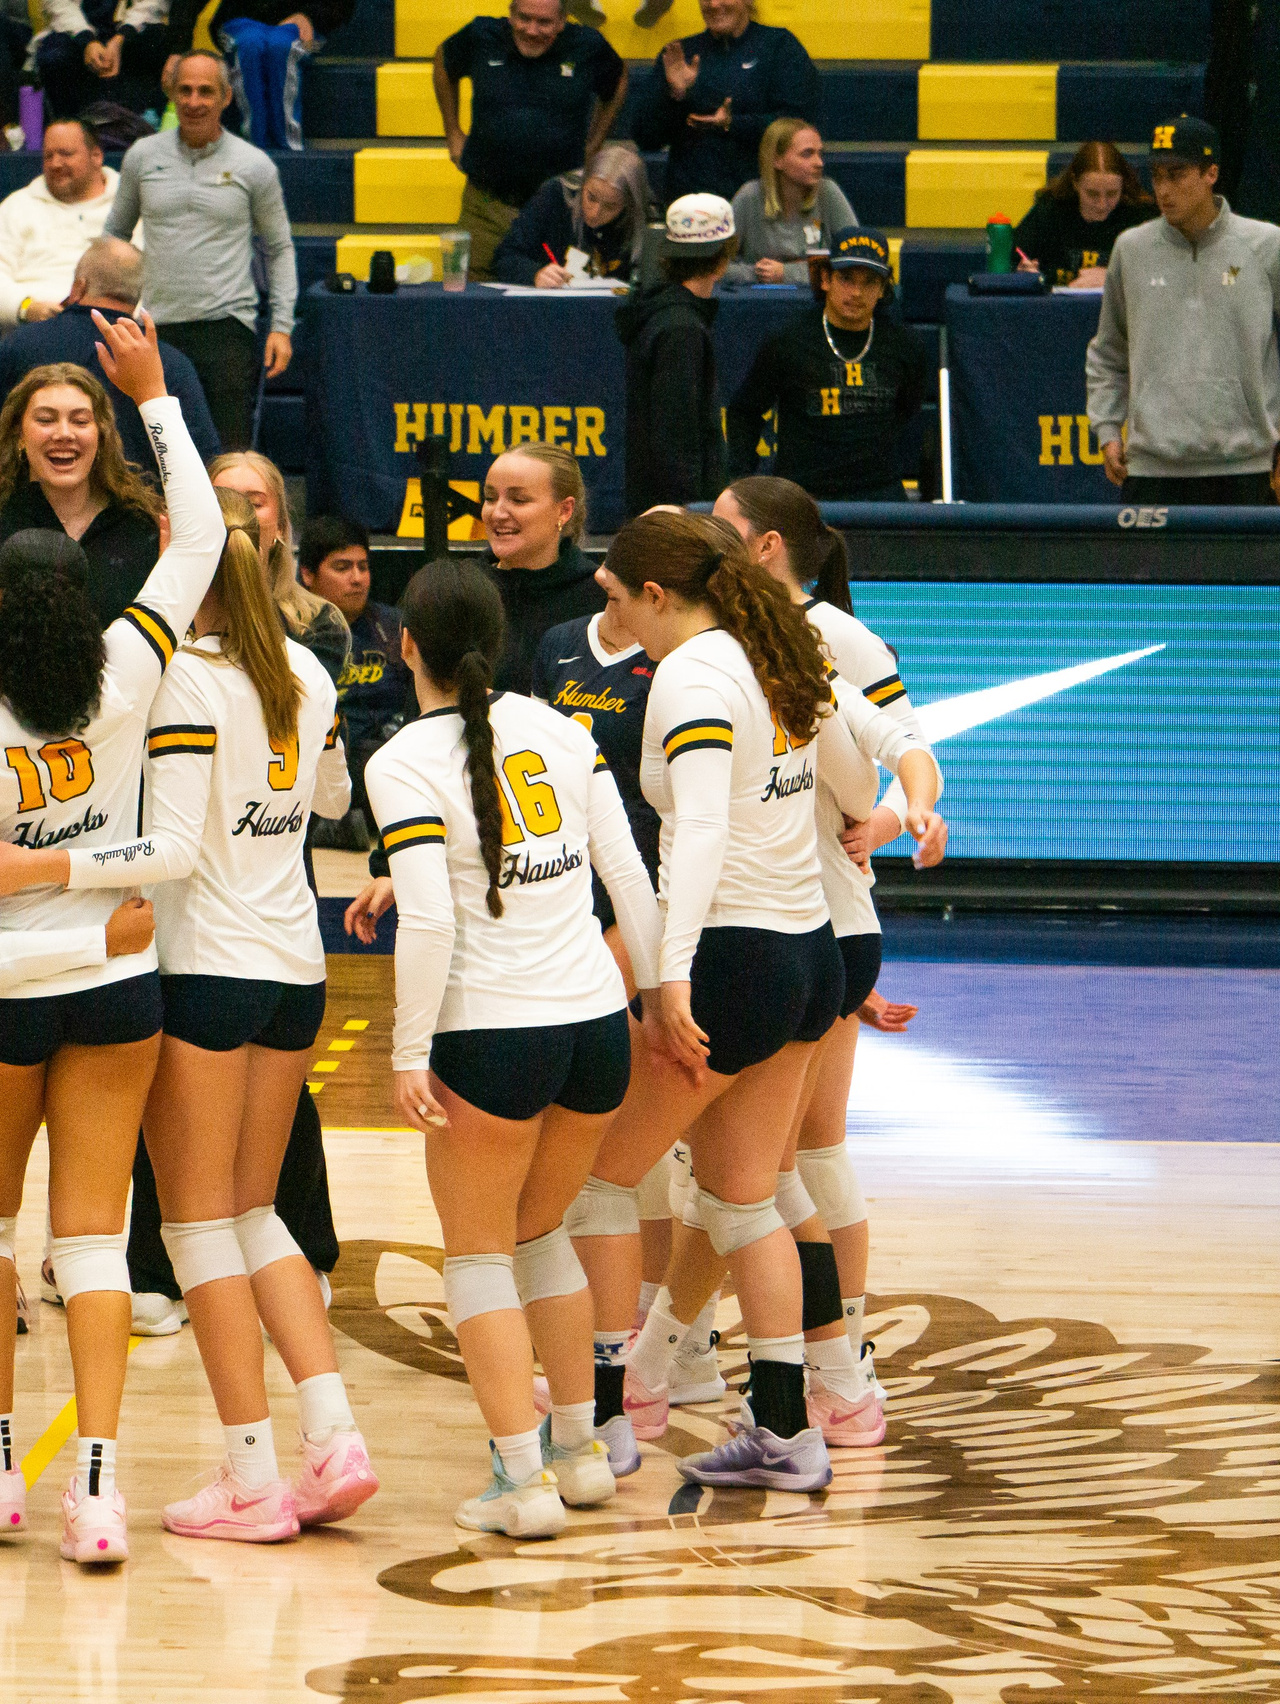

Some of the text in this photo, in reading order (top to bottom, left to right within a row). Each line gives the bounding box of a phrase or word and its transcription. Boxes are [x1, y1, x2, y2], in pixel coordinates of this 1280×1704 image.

[1152, 125, 1176, 149] H
[393, 403, 607, 457] HUMBER
[1038, 415, 1105, 465] HU
[1118, 507, 1169, 528] OES
[554, 680, 627, 713] Humber
[4, 737, 95, 814] 10
[760, 758, 814, 803] Hawks
[12, 804, 109, 850] Hawks
[231, 801, 304, 838] Hawks
[92, 840, 155, 866] Rollhawks
[497, 843, 584, 889] Hawks
